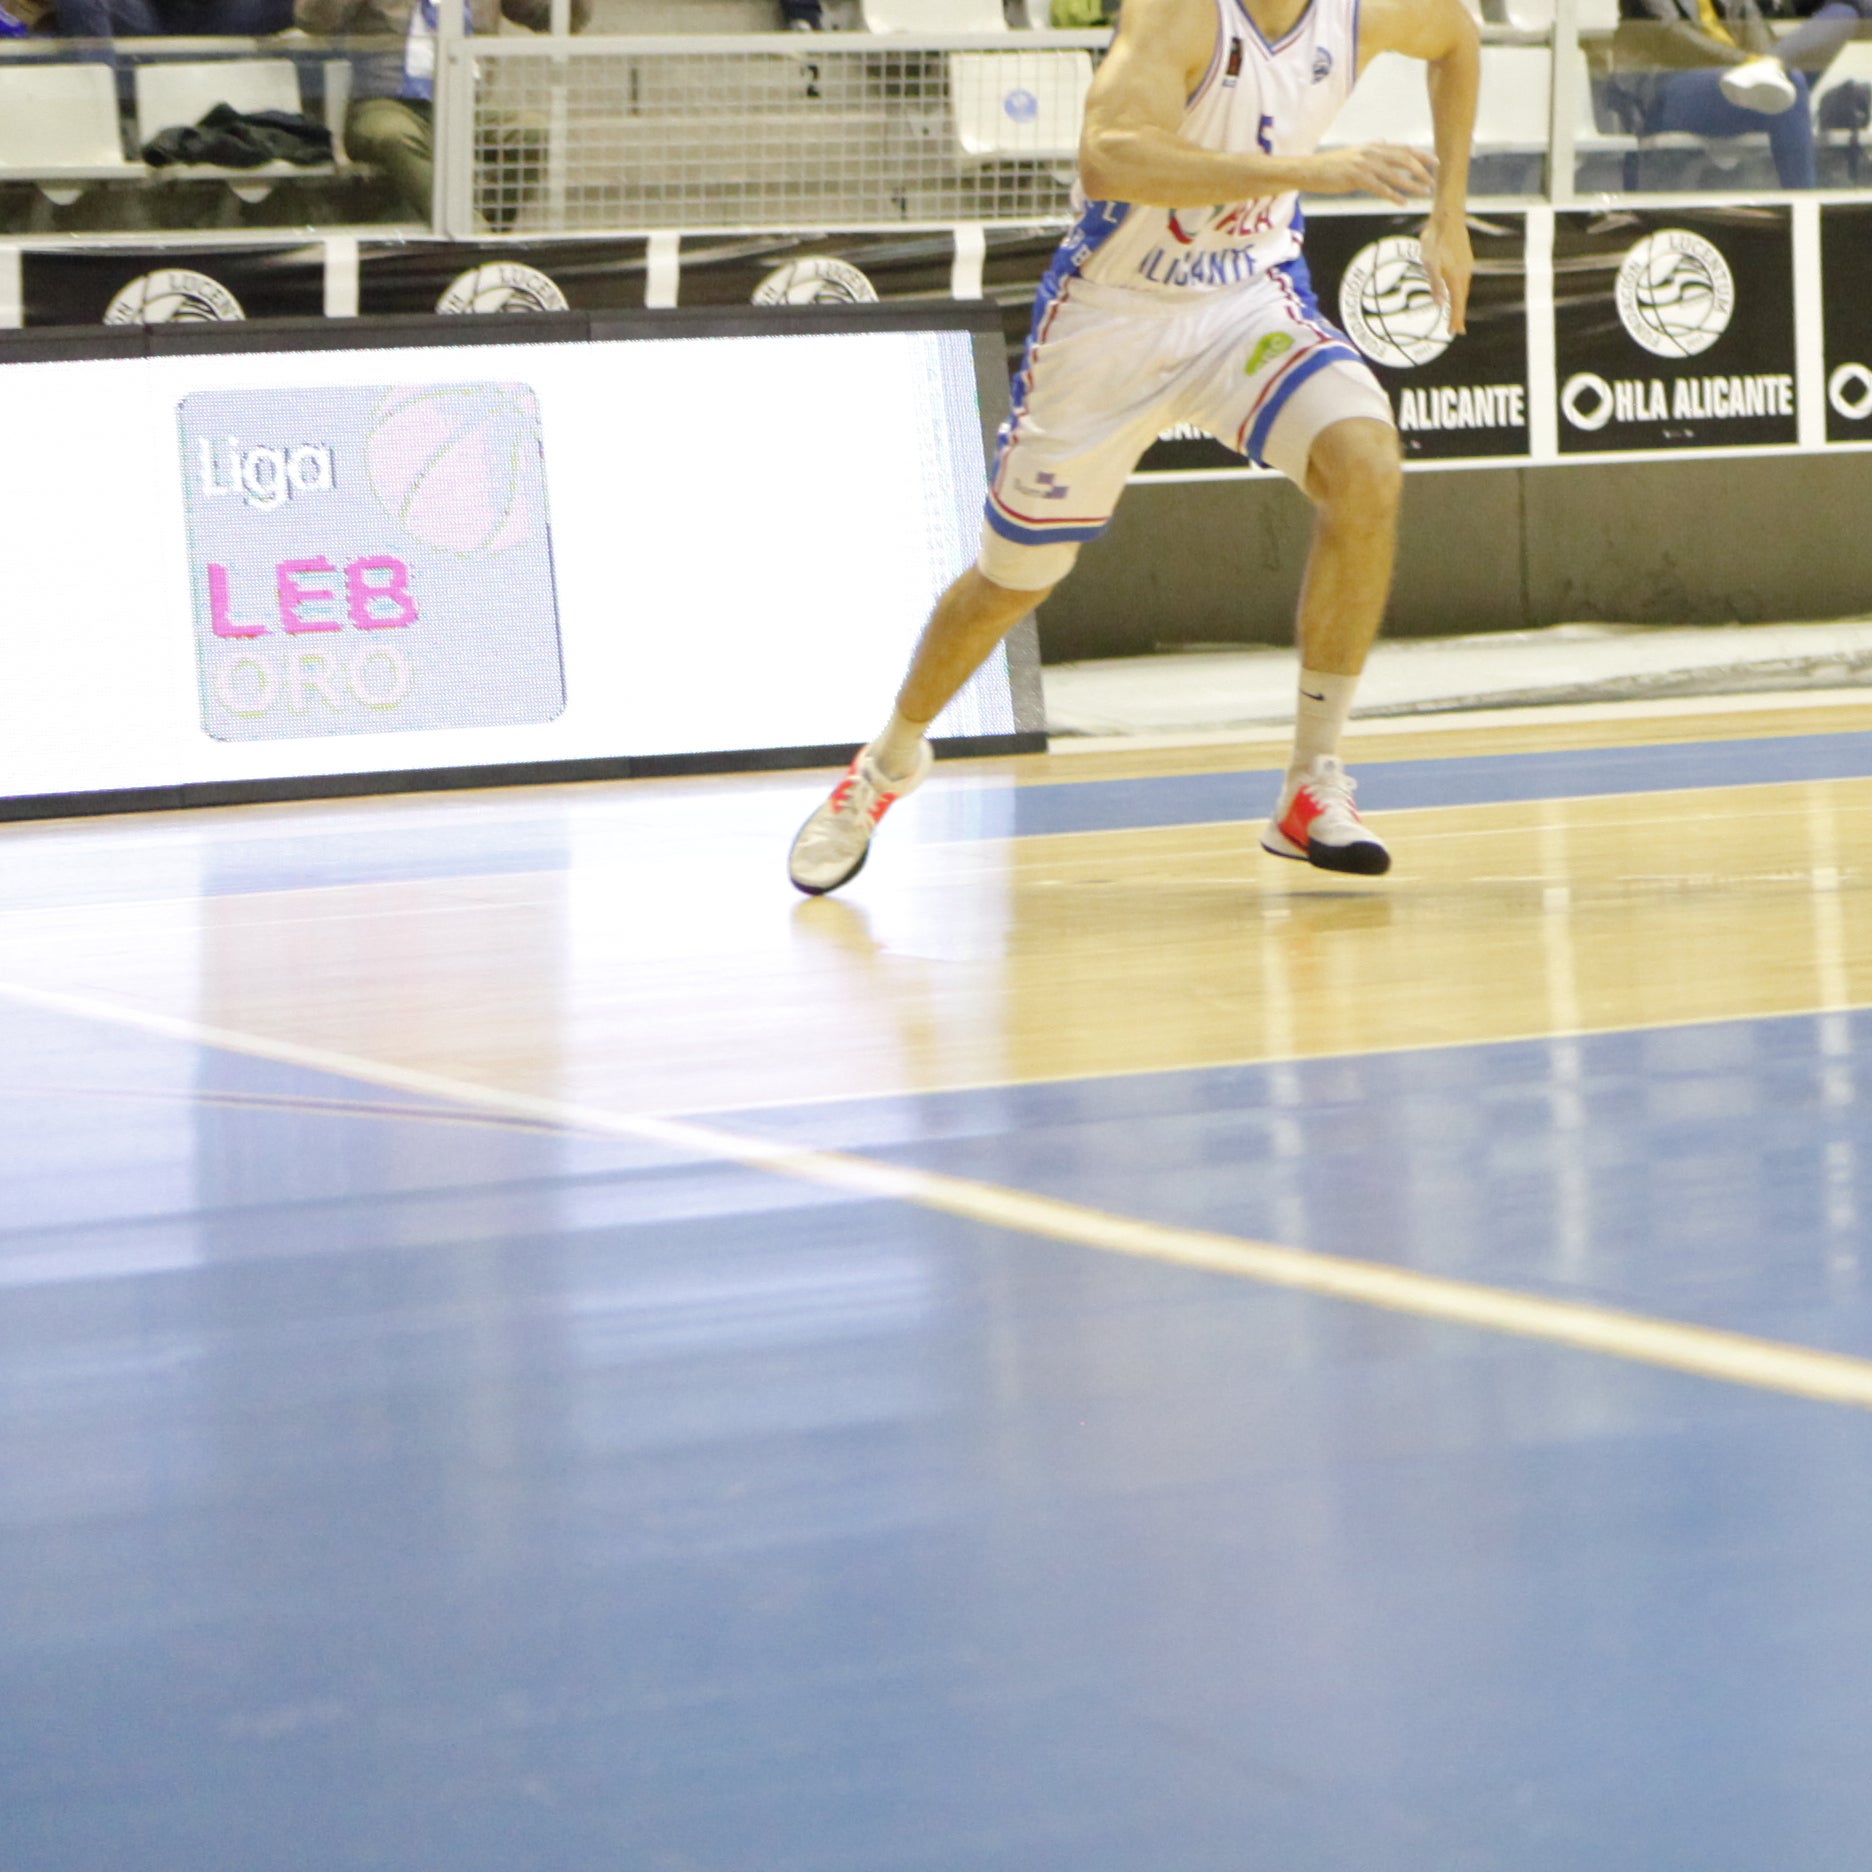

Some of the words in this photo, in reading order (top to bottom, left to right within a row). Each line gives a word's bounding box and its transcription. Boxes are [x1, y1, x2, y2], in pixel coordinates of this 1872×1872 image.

[1400, 383, 1526, 431] ALICANTE
[1672, 374, 1794, 420] ALICANTE
[200, 434, 338, 512] Liga
[207, 555, 420, 639] LEB
[211, 643, 416, 719] ORO
